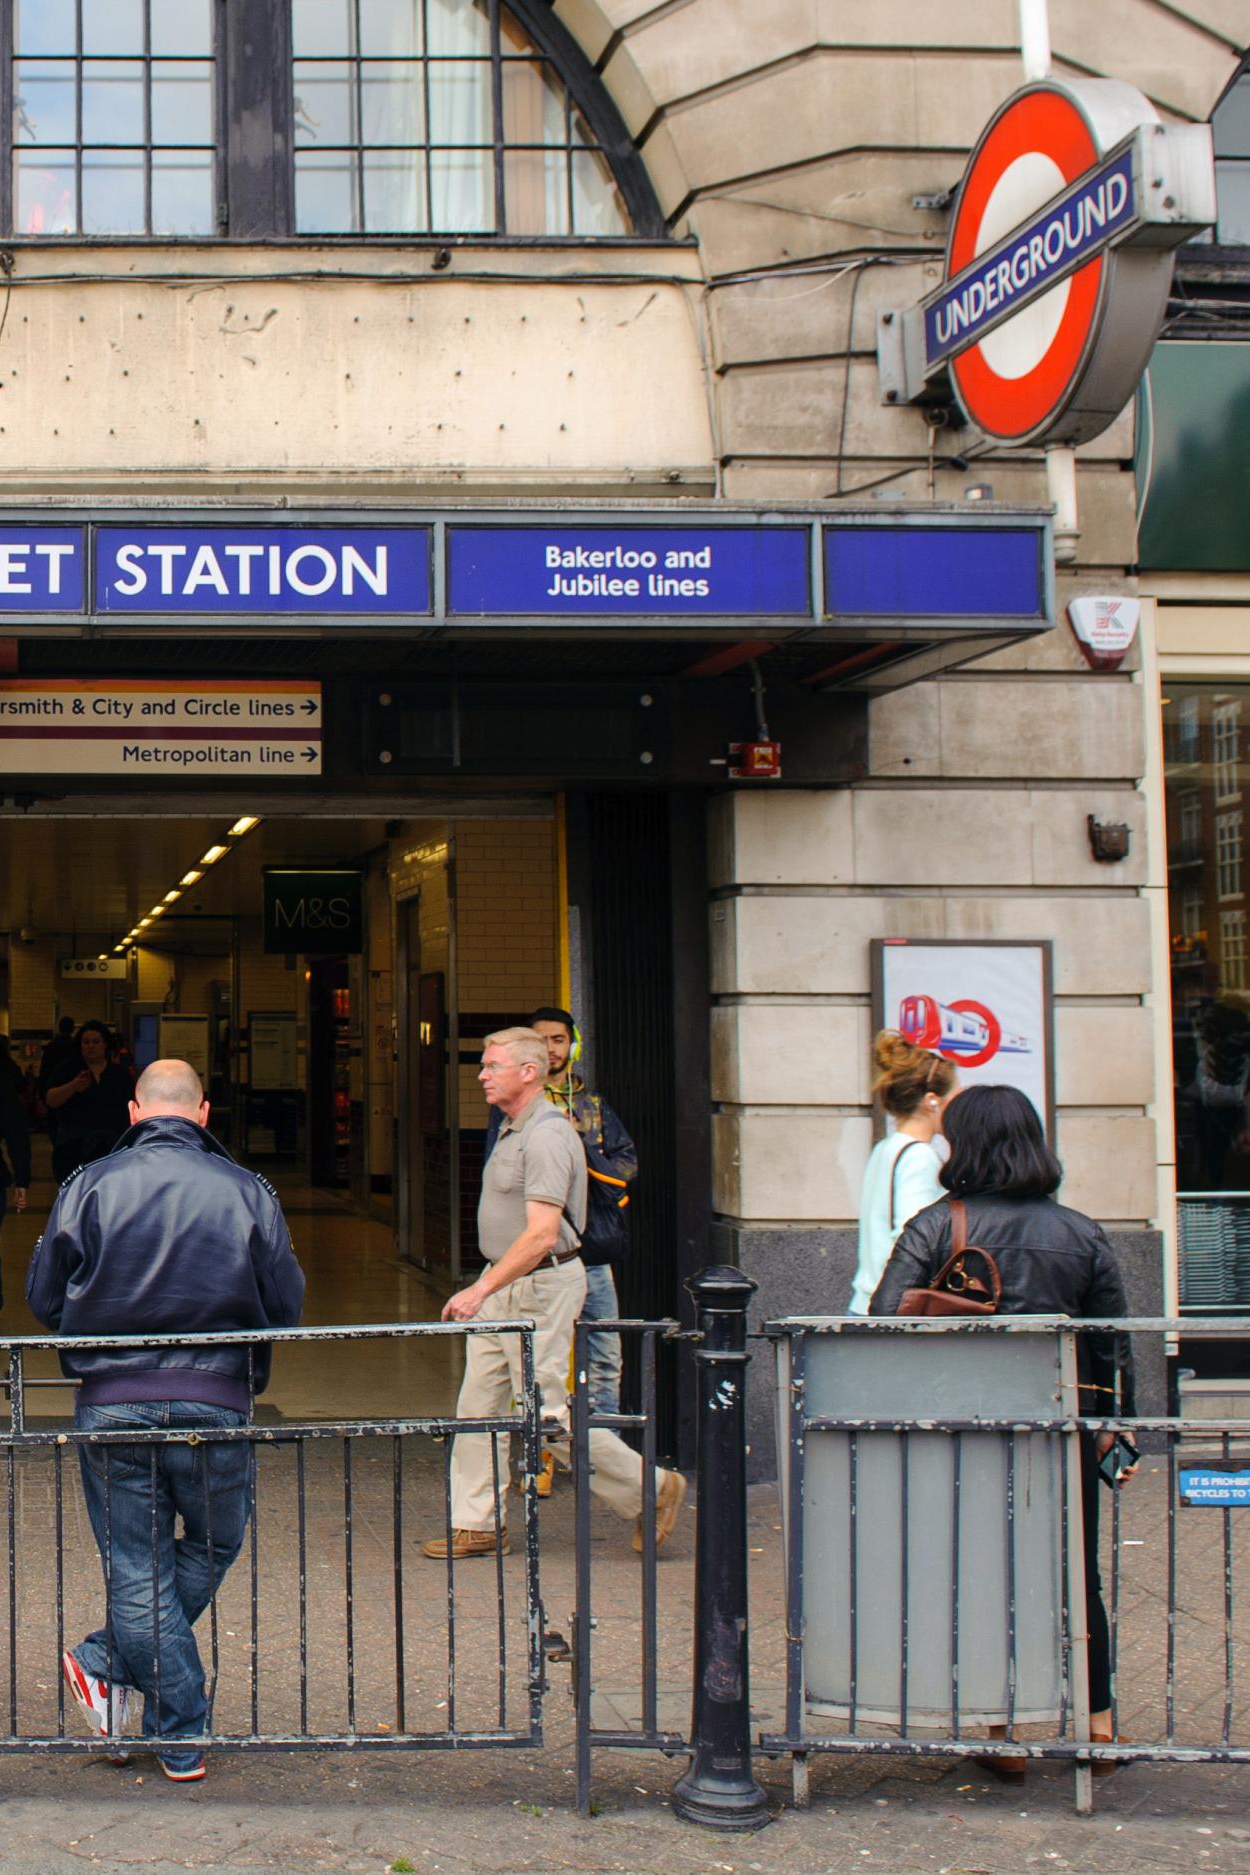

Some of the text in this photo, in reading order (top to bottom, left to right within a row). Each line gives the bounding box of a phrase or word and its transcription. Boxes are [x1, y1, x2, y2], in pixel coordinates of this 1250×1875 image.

[934, 171, 1128, 345] UNDERGROUND
[545, 545, 711, 569] Bakerloo and
[114, 544, 388, 596] STATION
[547, 574, 710, 597] Jubilee lines
[71, 698, 86, 716] &
[92, 698, 132, 719] City
[141, 699, 176, 716] and
[183, 699, 241, 716] Circle
[249, 700, 295, 717] lines
[122, 745, 295, 765] Metropolitan line
[275, 897, 351, 929] M&S
[1185, 1489, 1230, 1498] BICYCLES
[1230, 1489, 1246, 1498] TO
